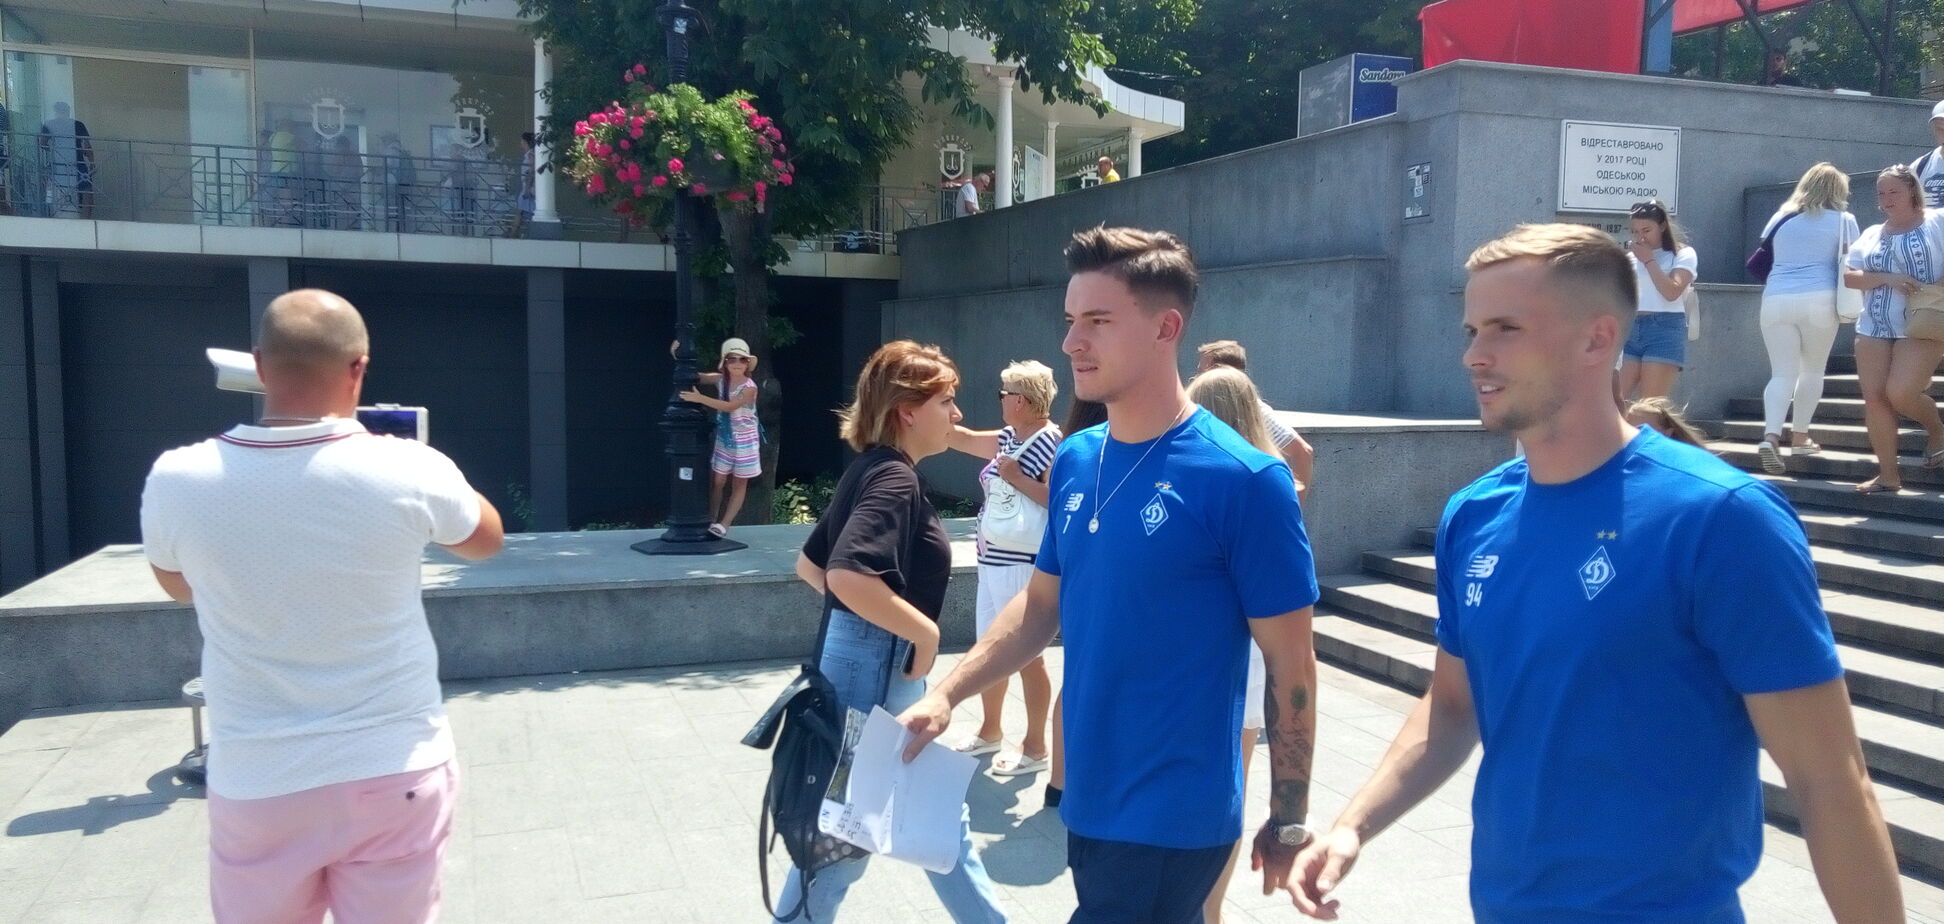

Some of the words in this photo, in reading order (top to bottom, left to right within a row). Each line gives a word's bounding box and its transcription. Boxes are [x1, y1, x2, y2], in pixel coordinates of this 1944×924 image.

[1580, 137, 1664, 151] ВІДРЕСТАВРОВАНО
[1597, 154, 1602, 163] У
[1605, 155, 1624, 164] 2017
[1626, 156, 1647, 166] РОЦІ
[1596, 170, 1646, 181] ОДЕСЬКОЮ
[1582, 185, 1624, 195] МІСЬКОЮ
[1626, 187, 1658, 197] РАДОЮ
[1464, 582, 1483, 607] 94
